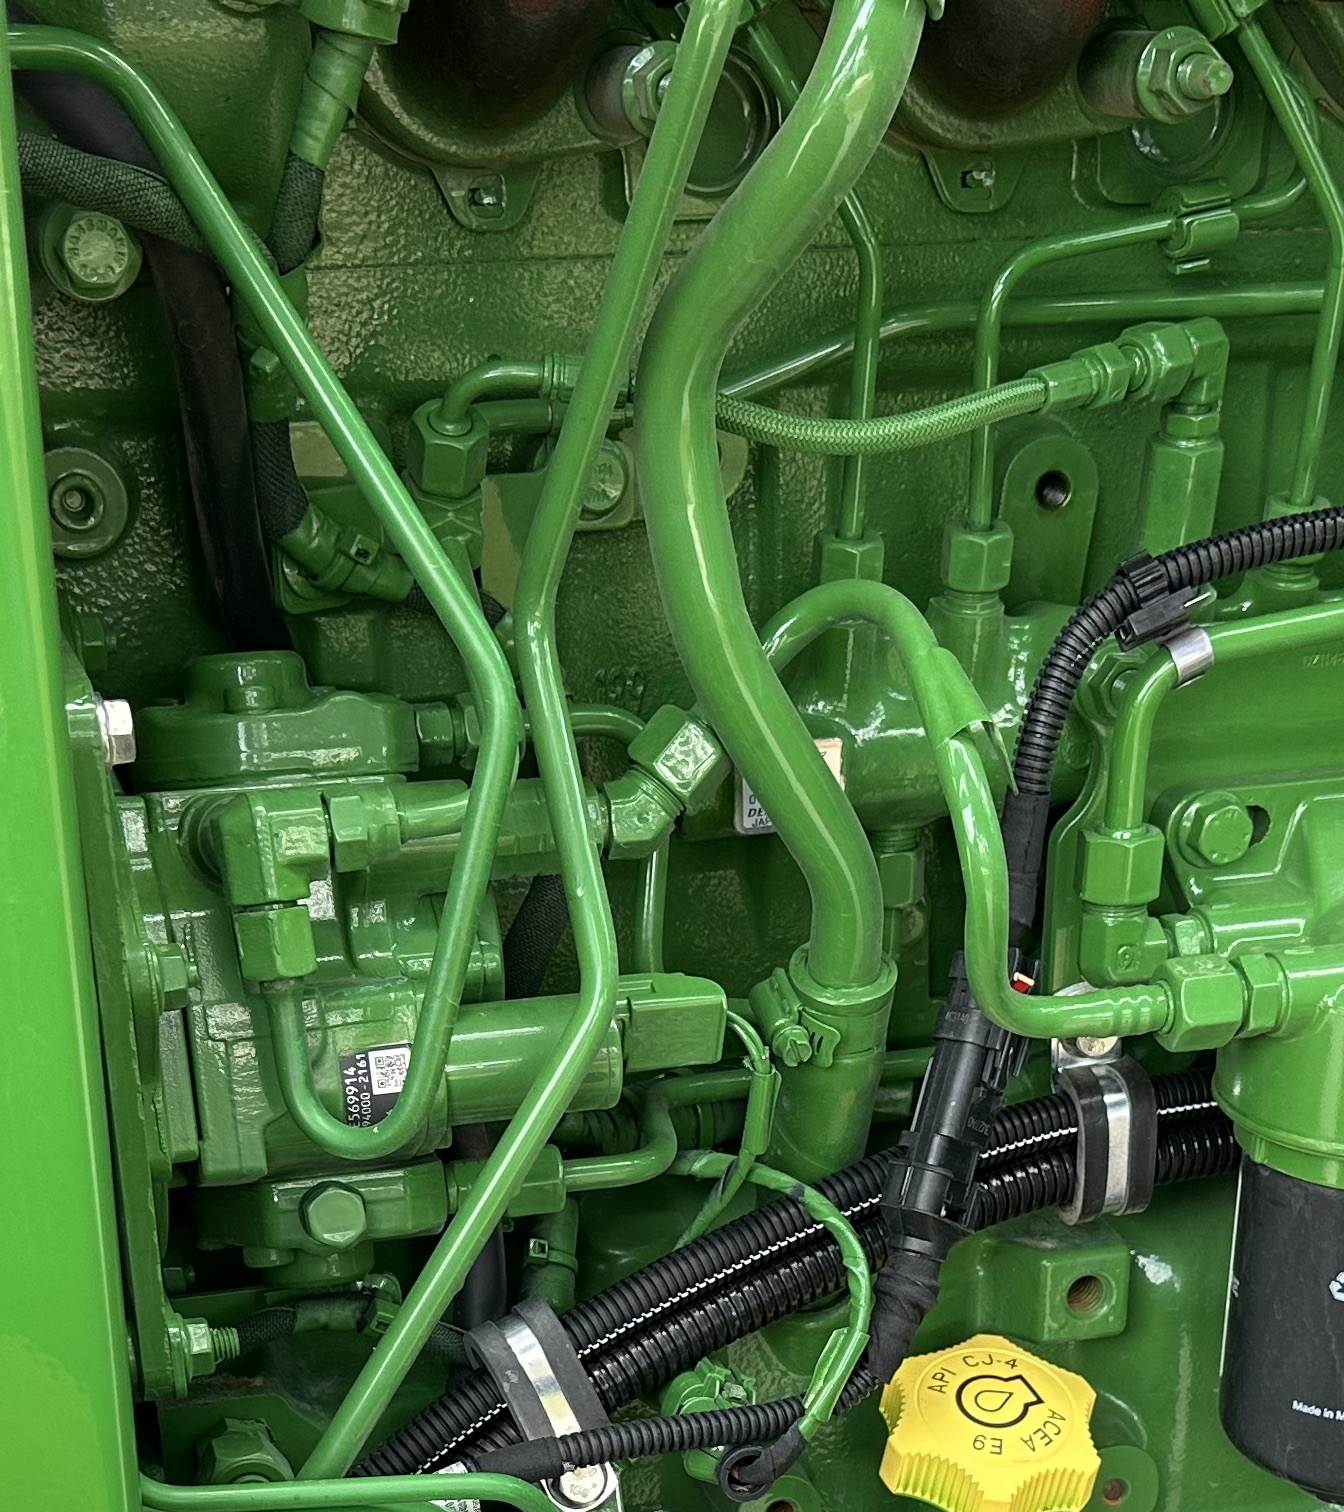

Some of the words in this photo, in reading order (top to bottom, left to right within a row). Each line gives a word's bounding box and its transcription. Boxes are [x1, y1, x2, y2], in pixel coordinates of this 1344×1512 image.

[747, 807, 769, 818] DE
[926, 1366, 957, 1395] API
[962, 1353, 1019, 1370] CJ-4
[1292, 1399, 1322, 1417] Made
[1322, 1407, 1334, 1419] in
[1019, 1408, 1067, 1453] ACEA
[972, 1434, 1004, 1456] E9
